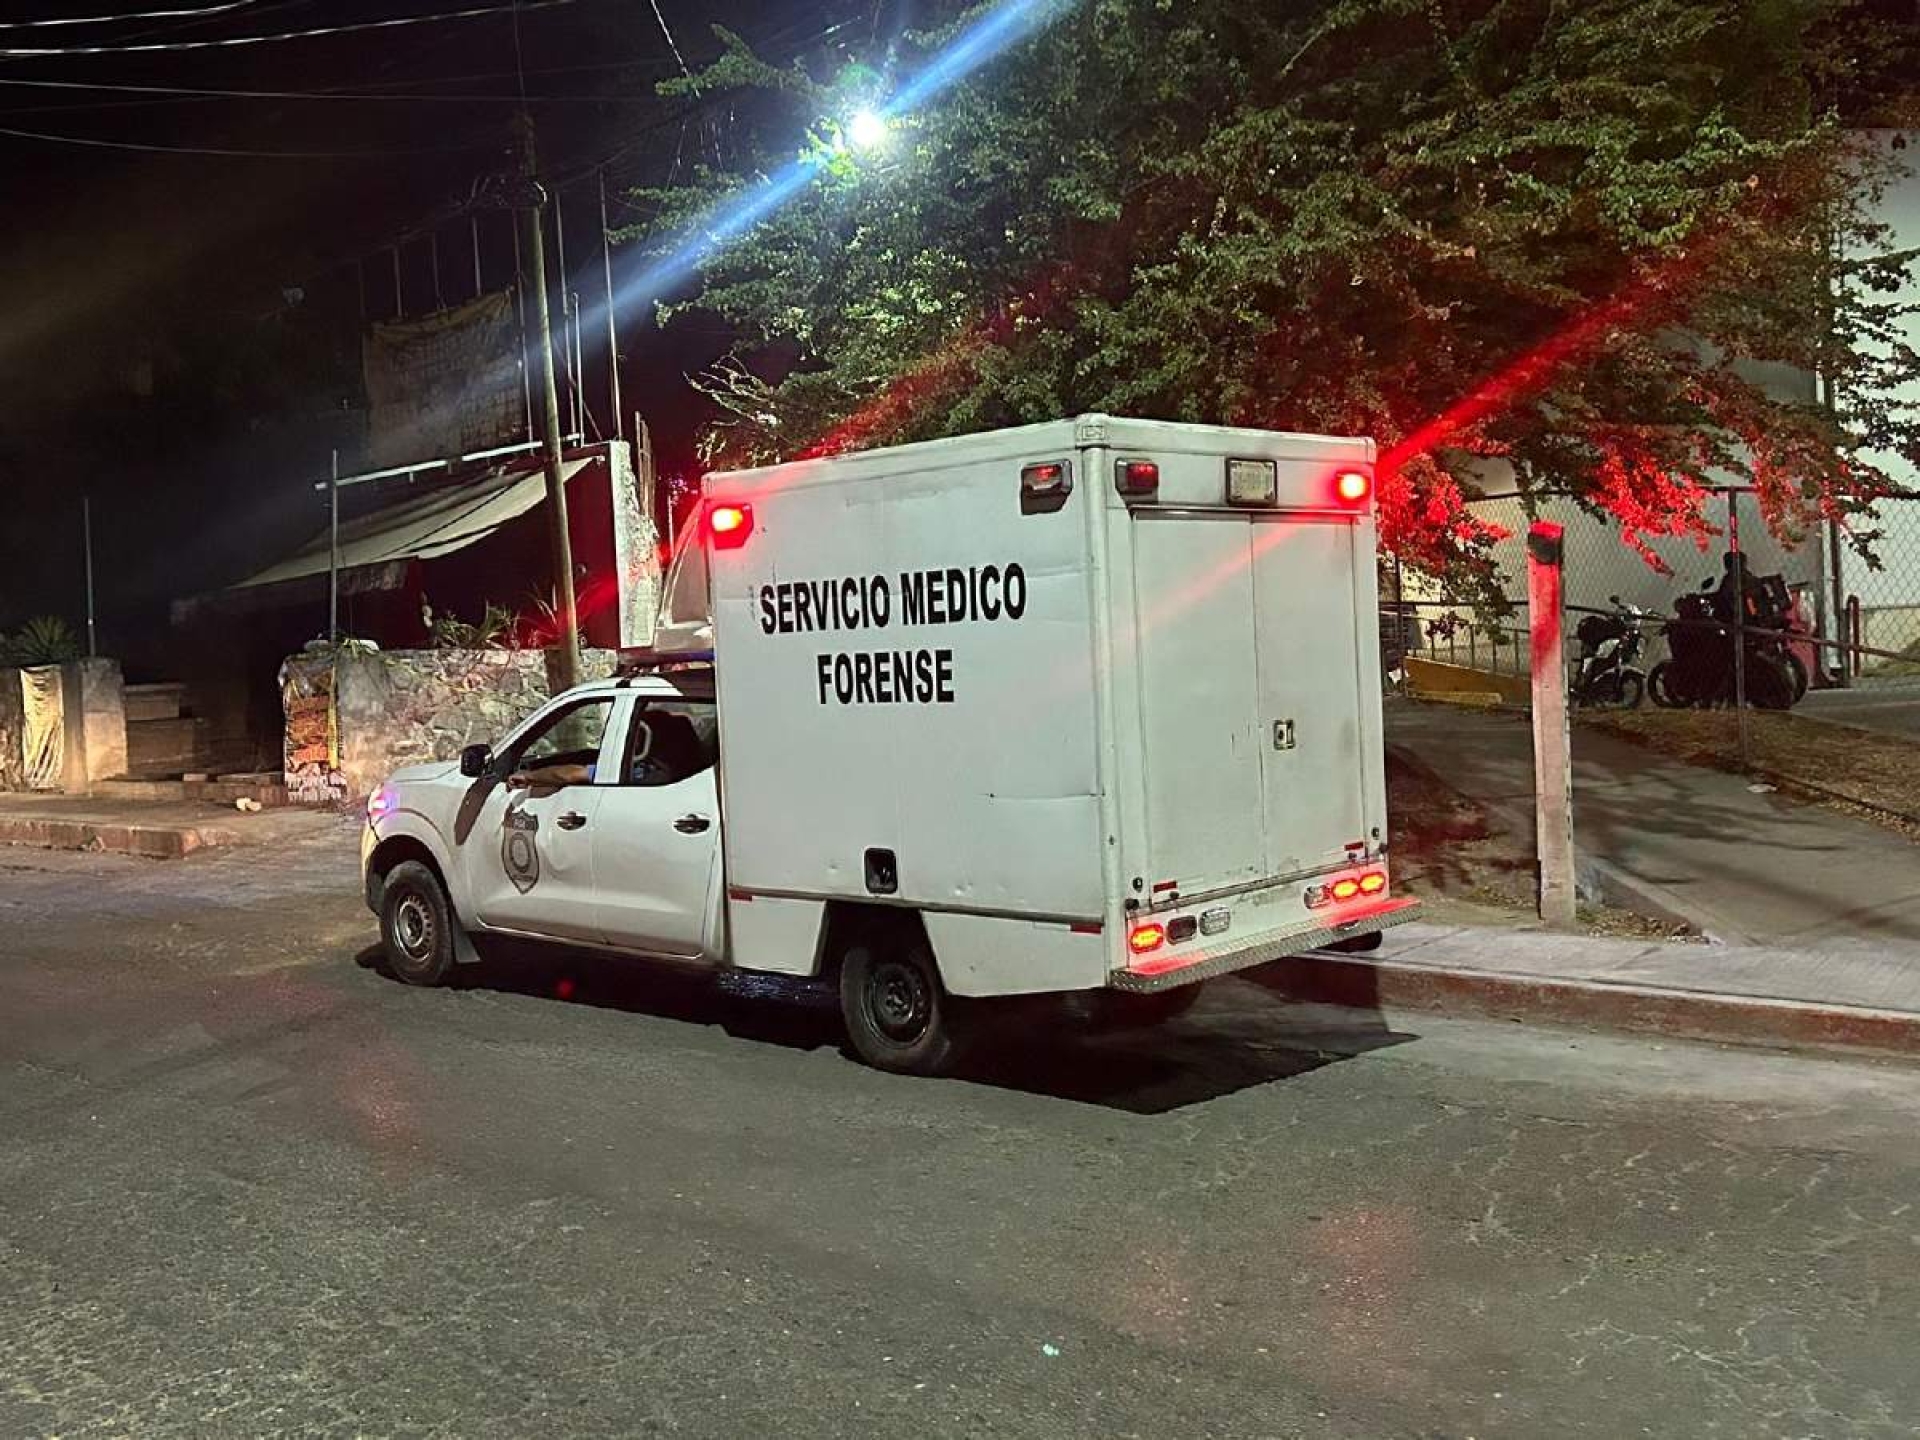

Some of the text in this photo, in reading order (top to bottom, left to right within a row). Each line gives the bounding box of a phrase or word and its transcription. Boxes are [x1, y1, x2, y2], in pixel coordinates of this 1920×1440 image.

[760, 563, 1026, 634] SERVICIO MEDICO
[817, 649, 955, 704] FORENSE
